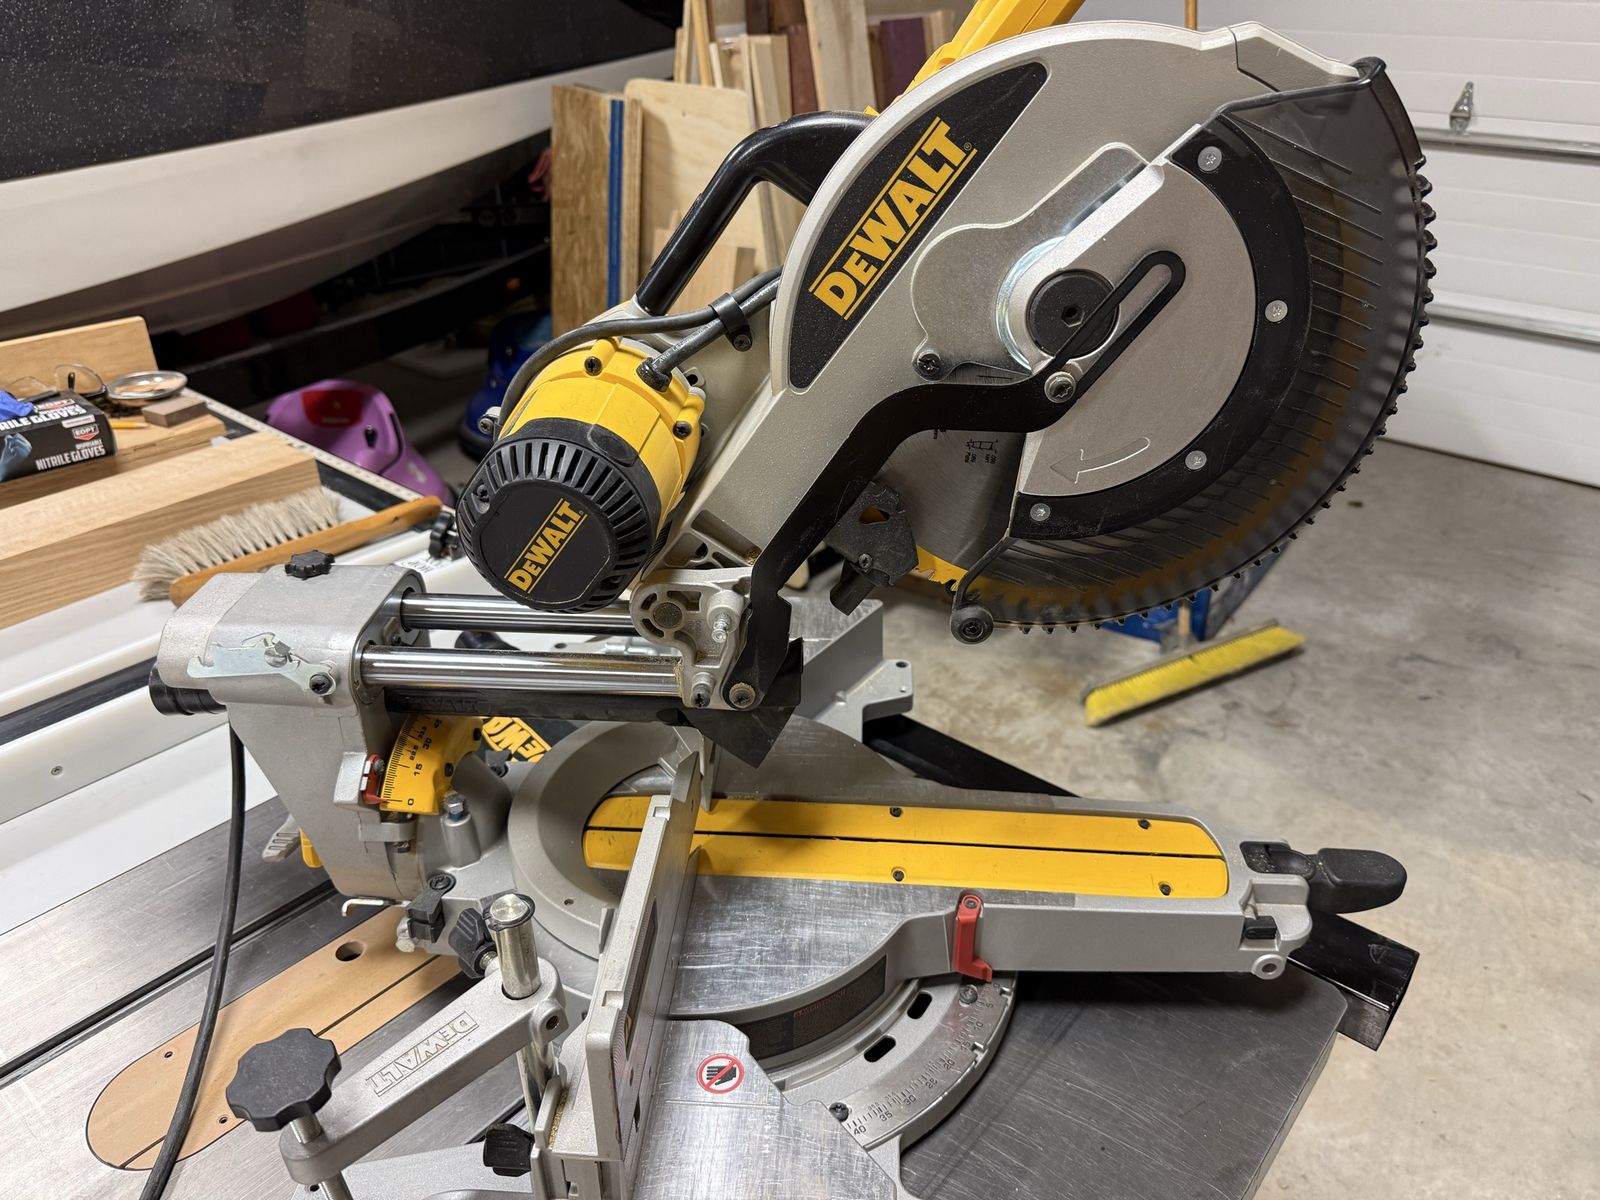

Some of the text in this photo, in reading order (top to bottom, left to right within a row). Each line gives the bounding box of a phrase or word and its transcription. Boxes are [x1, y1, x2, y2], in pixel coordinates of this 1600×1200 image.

[813, 119, 970, 318] DEWALT
[30, 404, 87, 424] GLOVES
[35, 445, 106, 471] NITRILE GLOVES
[507, 500, 582, 592] DEWALT
[422, 737, 432, 750] 30
[413, 763, 423, 776] 15
[407, 798, 414, 806] 0
[369, 1011, 479, 1096] DEWALT
[943, 1058, 955, 1070] 20
[903, 1094, 917, 1106] 30
[879, 1110, 893, 1122] 35
[853, 1125, 867, 1136] 40
